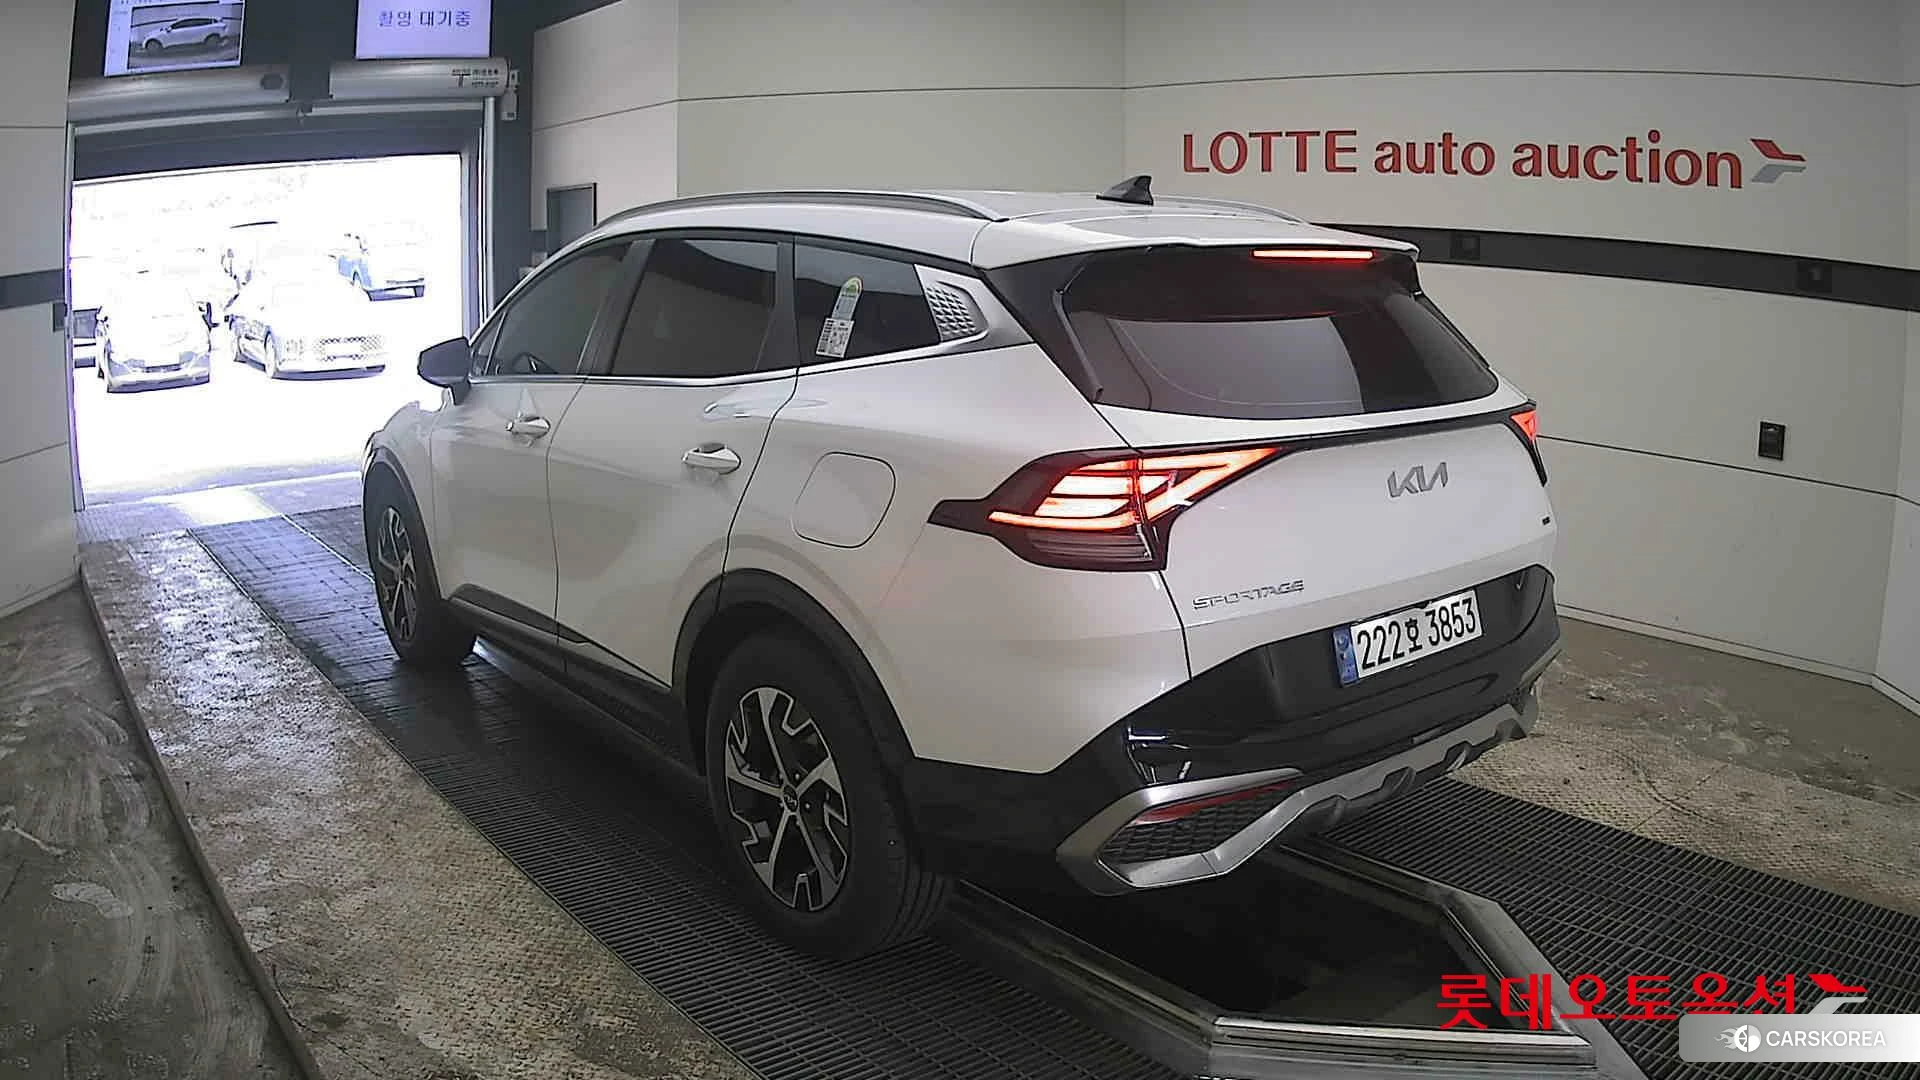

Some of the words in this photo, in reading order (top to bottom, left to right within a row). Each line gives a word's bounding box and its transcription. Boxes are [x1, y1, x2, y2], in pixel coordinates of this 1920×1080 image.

[419, 10, 472, 27] 대기중
[1183, 130, 1357, 174] LOTTE
[1374, 132, 1496, 176] auto
[1512, 129, 1742, 189] auction
[1387, 461, 1448, 498] KIA
[1192, 579, 1304, 610] SPORTAGE
[1357, 617, 1423, 670] 222호
[1425, 597, 1476, 647] 3853
